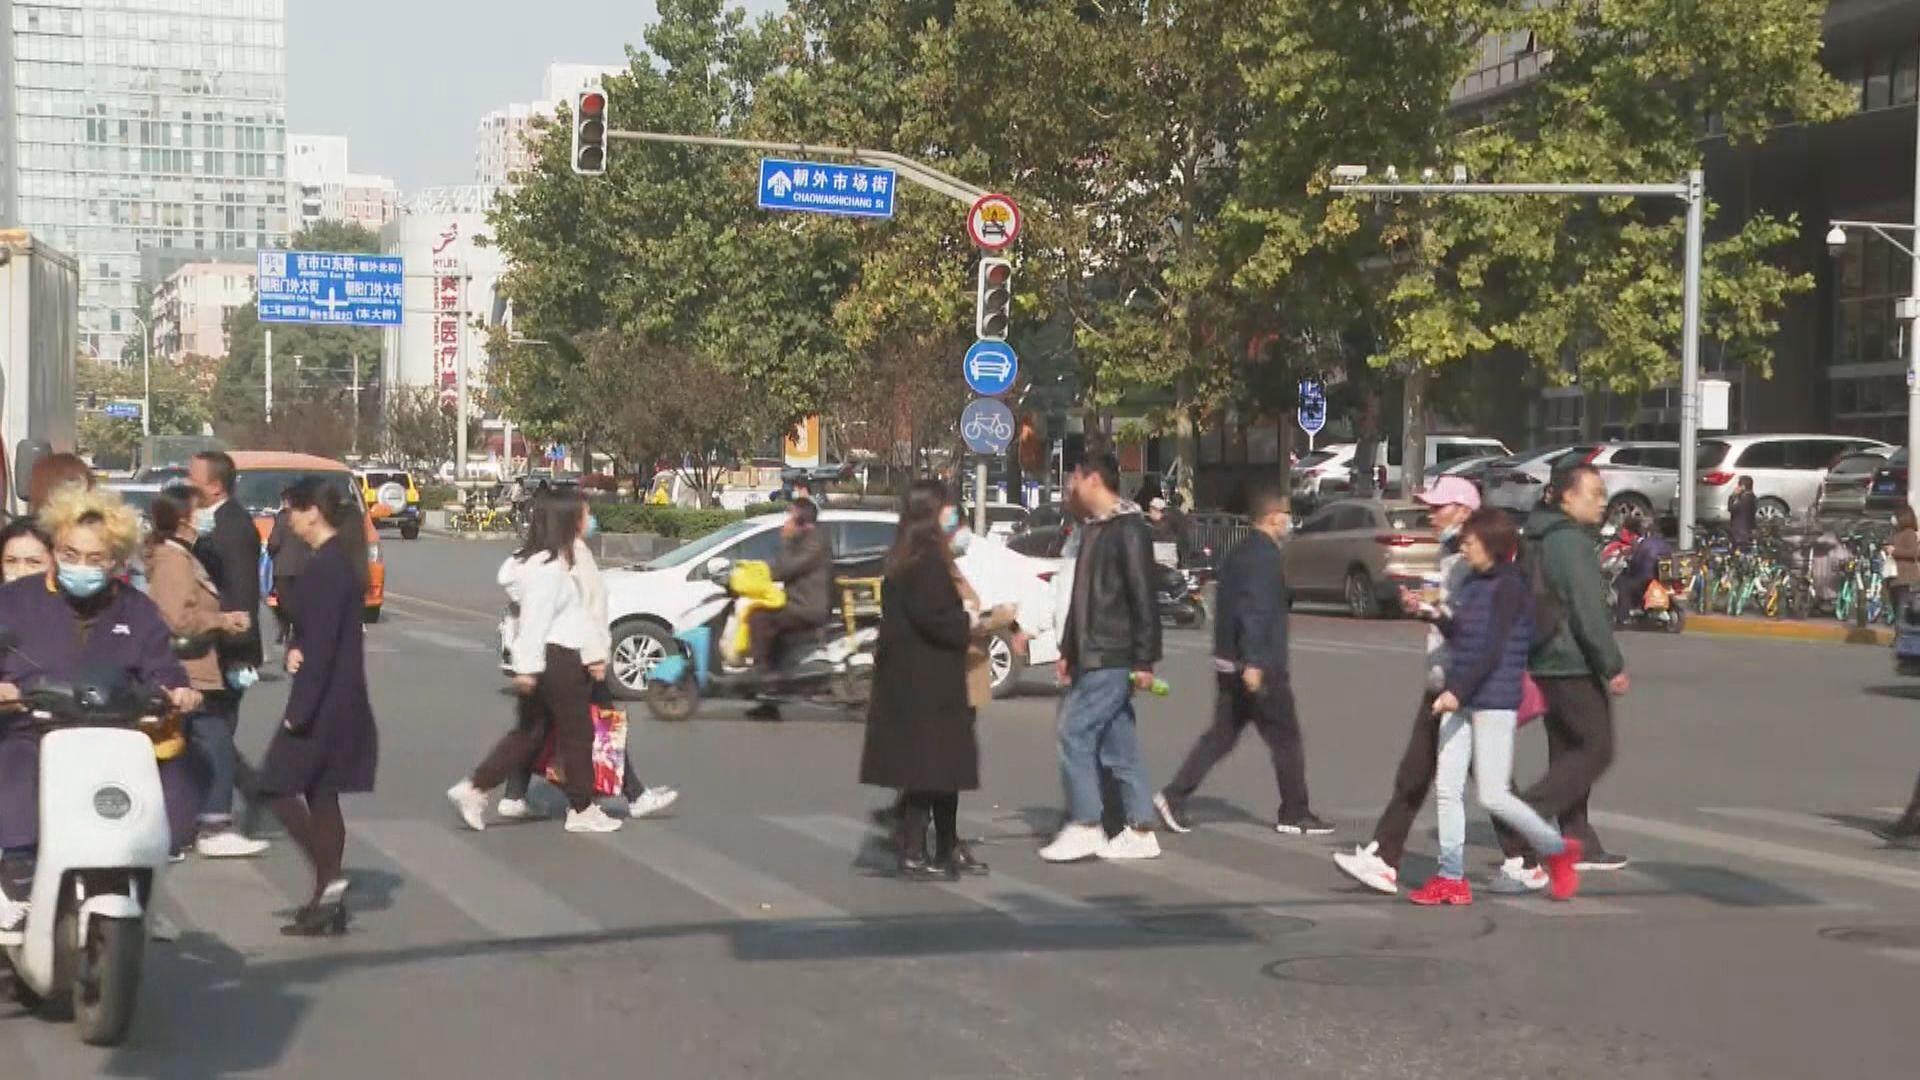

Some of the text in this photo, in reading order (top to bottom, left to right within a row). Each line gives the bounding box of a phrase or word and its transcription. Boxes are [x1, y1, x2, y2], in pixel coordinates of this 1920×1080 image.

[792, 168, 888, 195] 朝外市场街
[793, 192, 872, 208] CHAOWAISHICHANG
